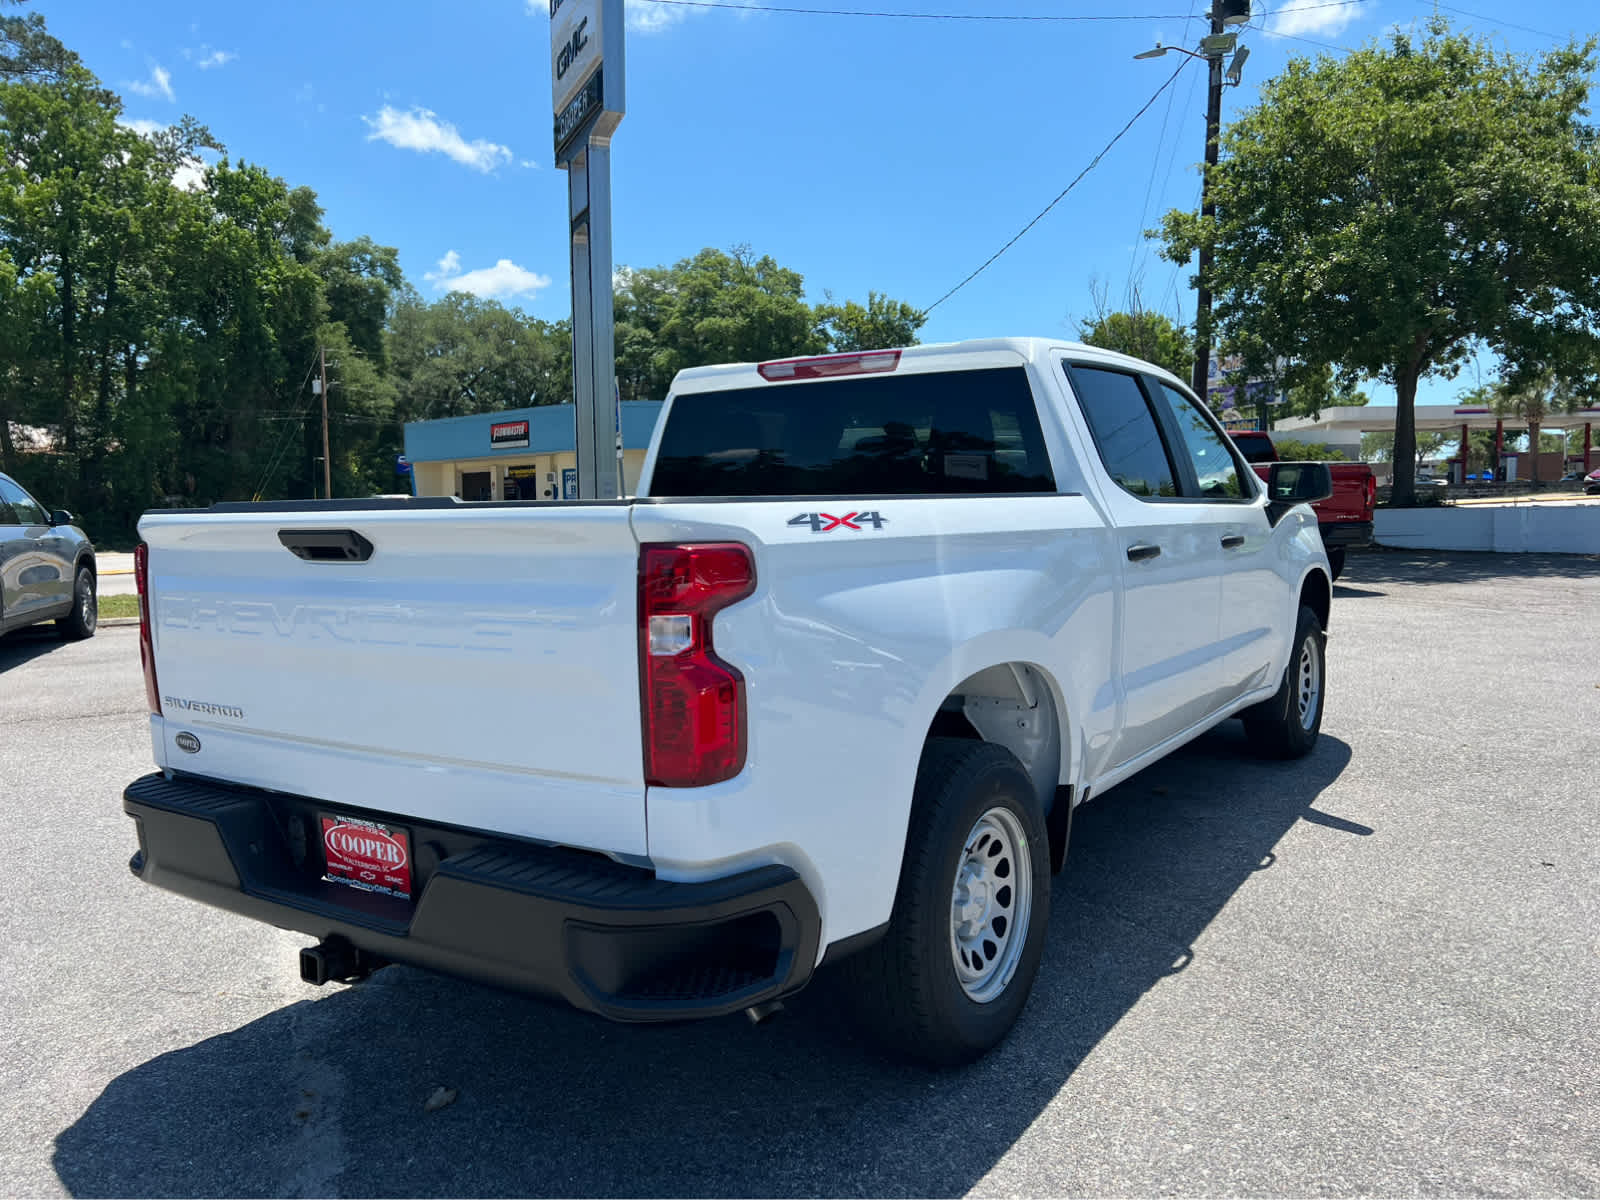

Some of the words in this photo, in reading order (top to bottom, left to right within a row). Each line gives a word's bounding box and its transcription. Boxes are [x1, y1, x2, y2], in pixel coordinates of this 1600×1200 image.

[557, 16, 588, 80] GMC
[164, 695, 244, 719] SILVERADO
[330, 831, 399, 864] COOPER
